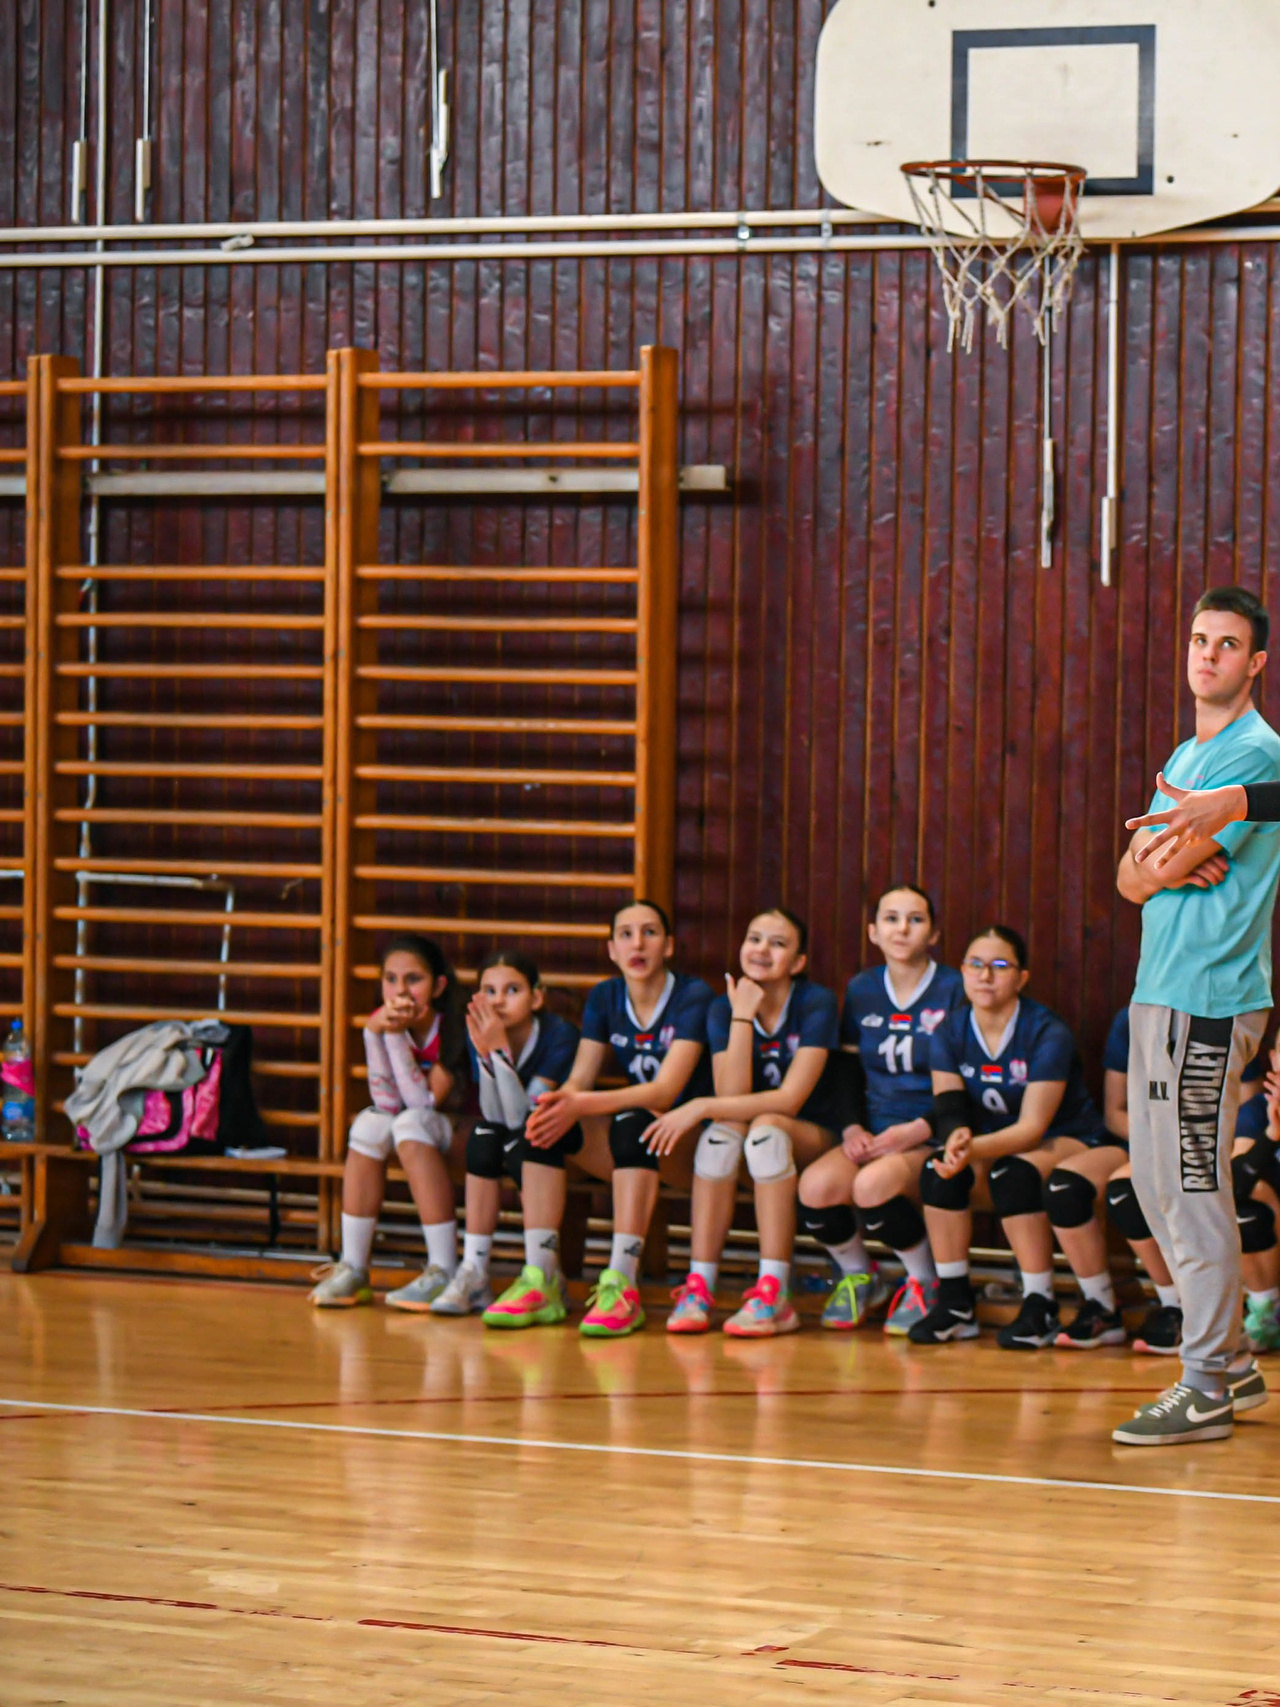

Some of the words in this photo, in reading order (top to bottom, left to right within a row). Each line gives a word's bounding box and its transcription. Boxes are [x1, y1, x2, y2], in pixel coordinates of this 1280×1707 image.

[877, 1034, 913, 1074] 11
[1180, 1040, 1229, 1116] VOLLEY
[1180, 1120, 1218, 1190] BLOCK
